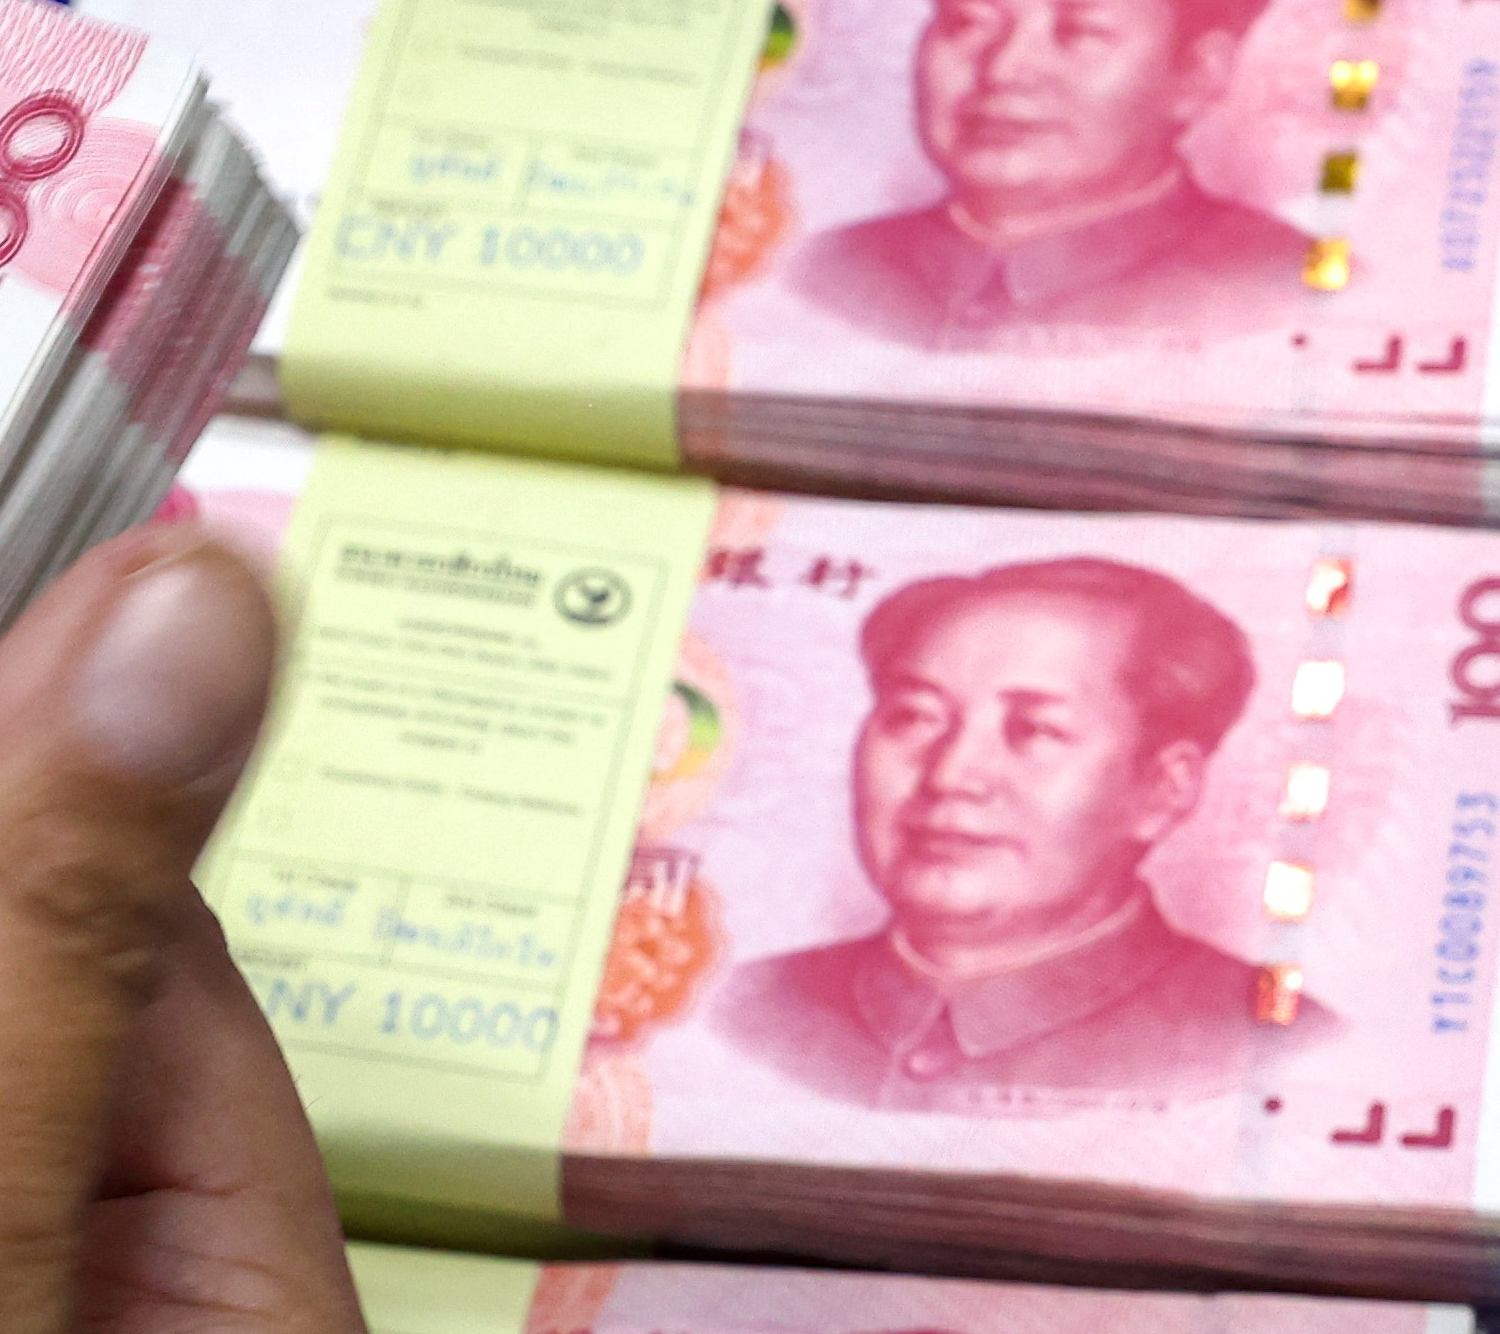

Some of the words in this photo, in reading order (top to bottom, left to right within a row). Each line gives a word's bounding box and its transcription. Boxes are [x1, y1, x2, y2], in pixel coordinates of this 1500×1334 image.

[336, 213, 459, 261] CNY
[479, 225, 646, 275] 10000
[382, 989, 560, 1053] 10000
